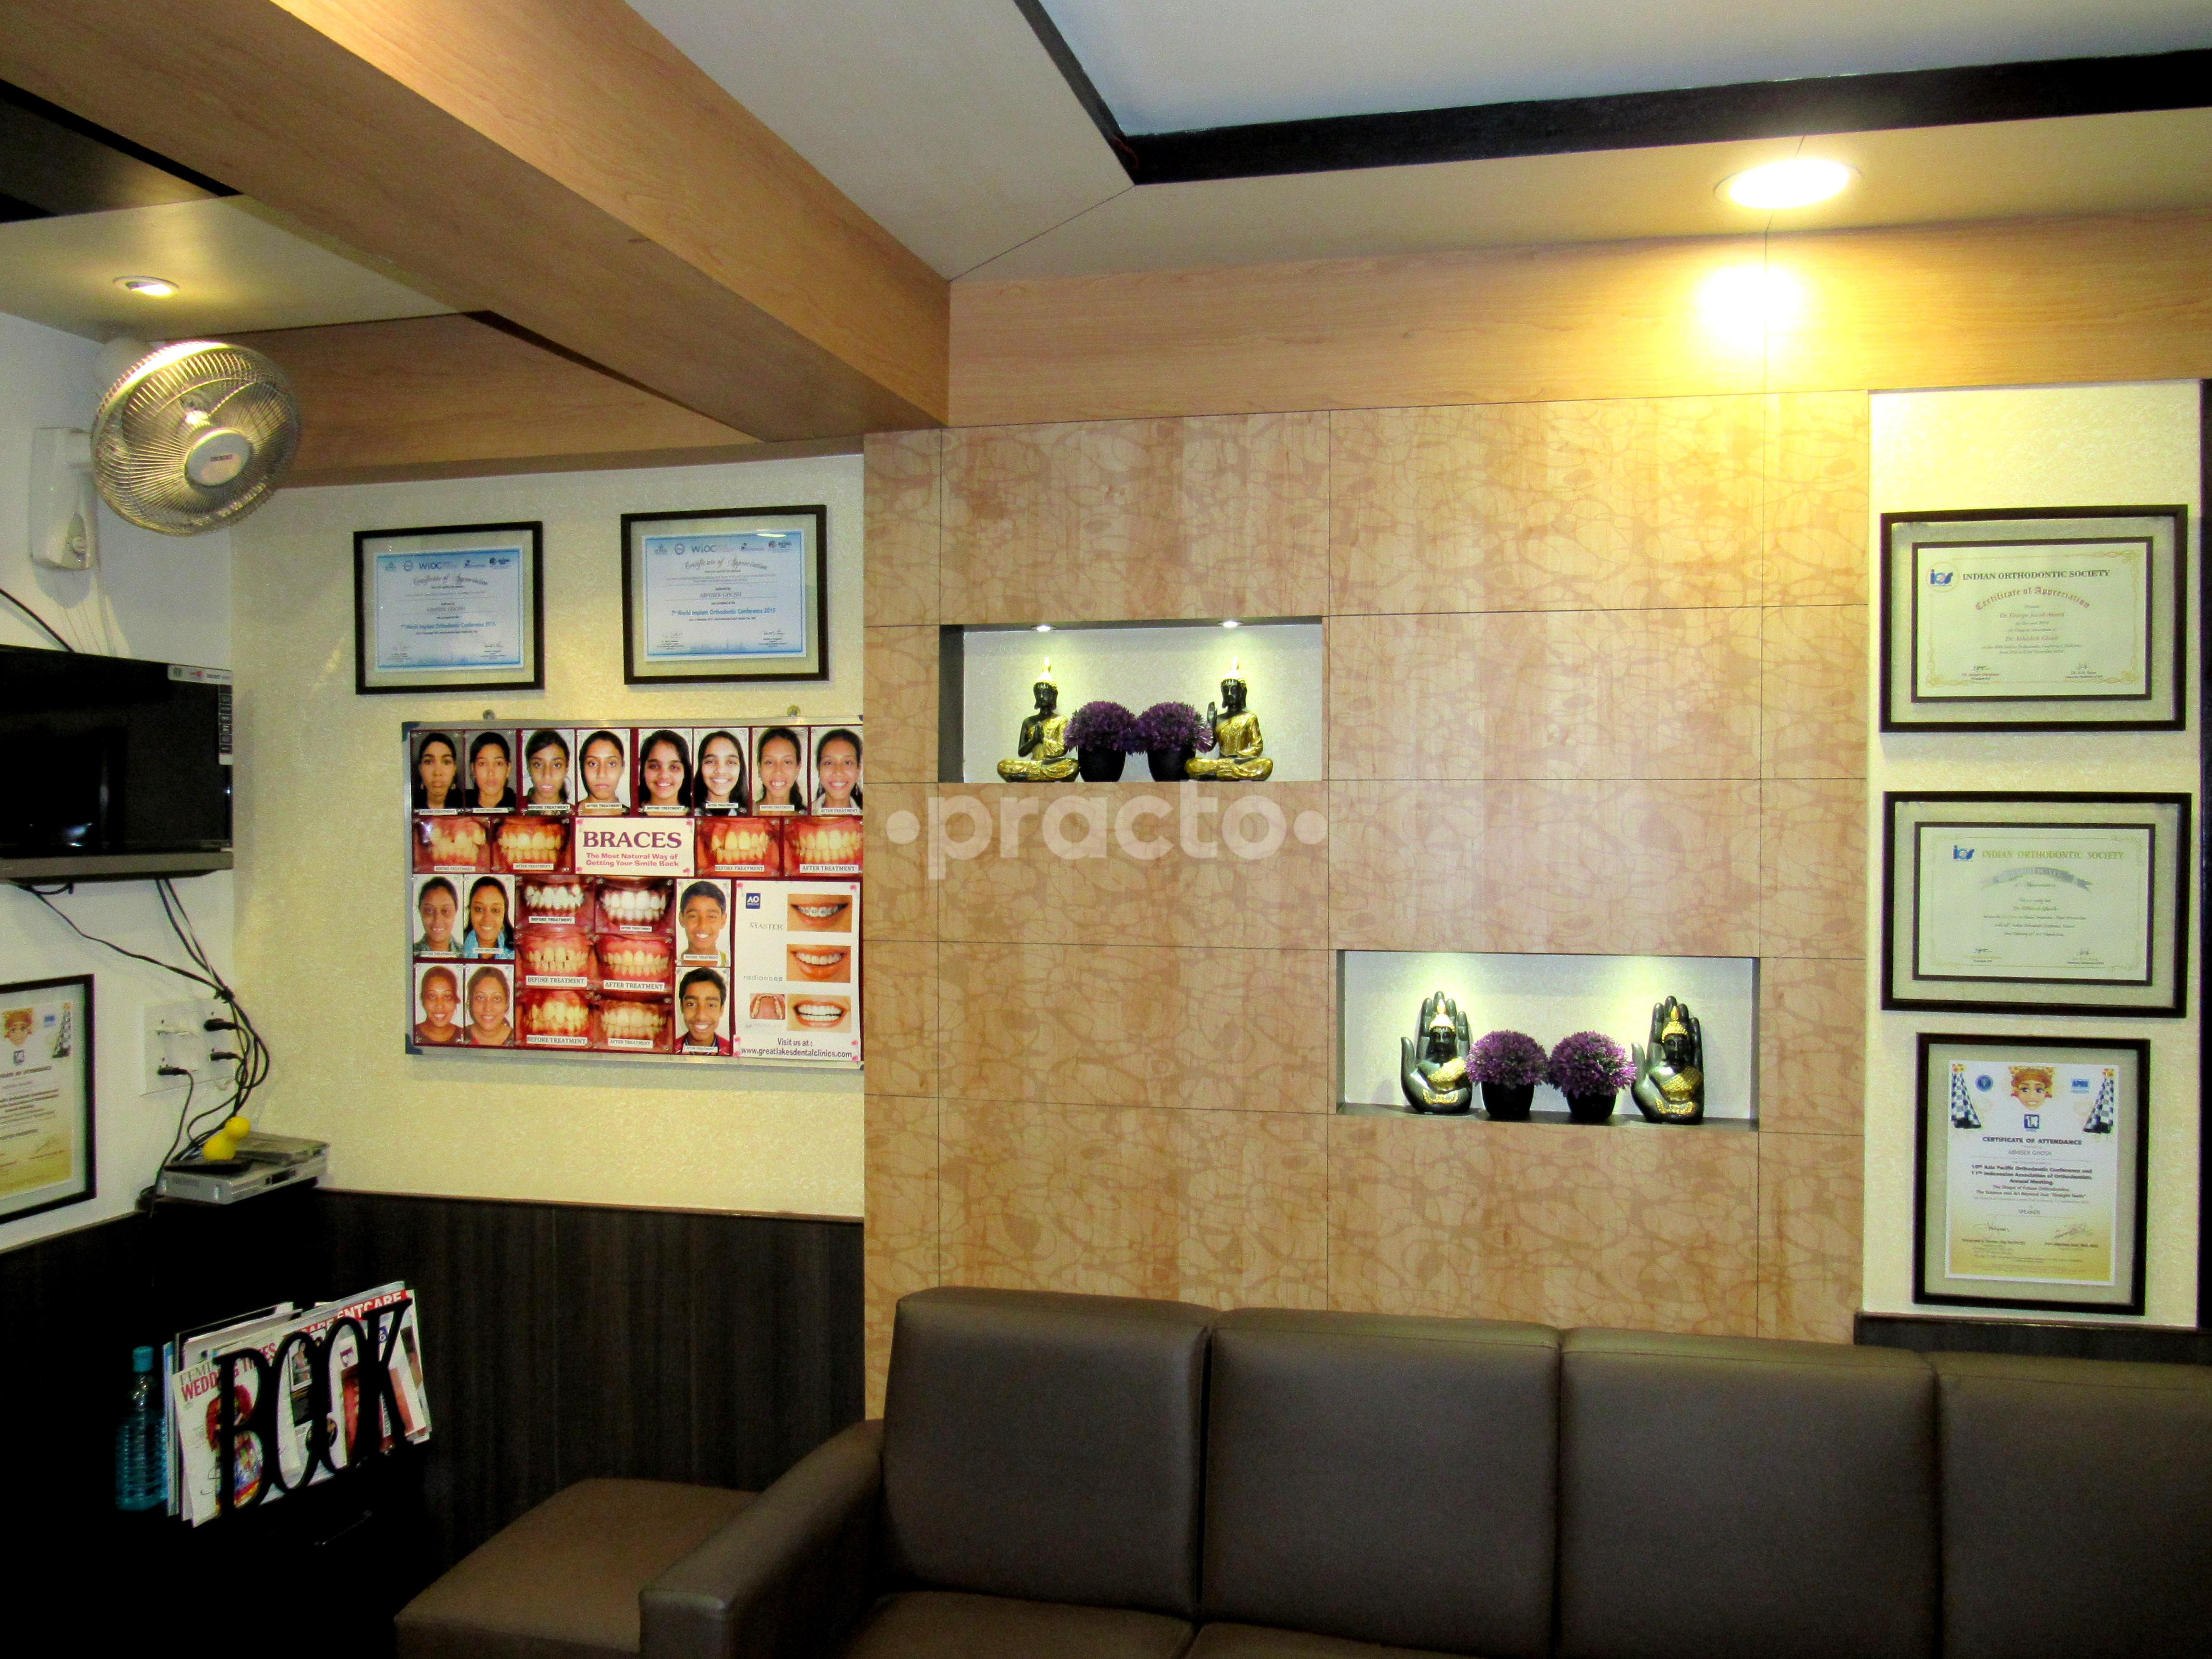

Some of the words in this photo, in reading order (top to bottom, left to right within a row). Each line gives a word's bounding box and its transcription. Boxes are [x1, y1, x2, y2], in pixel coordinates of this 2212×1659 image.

[1962, 572, 1996, 580] INDIAN
[1998, 571, 2067, 580] ORTHODONTIC
[2069, 569, 2110, 577] SOCIETY
[1975, 589, 2020, 610] Certificate
[2035, 586, 2090, 609] Appreciation
[583, 831, 682, 848] BRACES
[2018, 850, 2082, 859] ORTHODONTIC
[2087, 851, 2124, 860] SOCIETY
[778, 1037, 792, 1046] Visit
[741, 1047, 853, 1058] www.greatlakesdentalclinics.com
